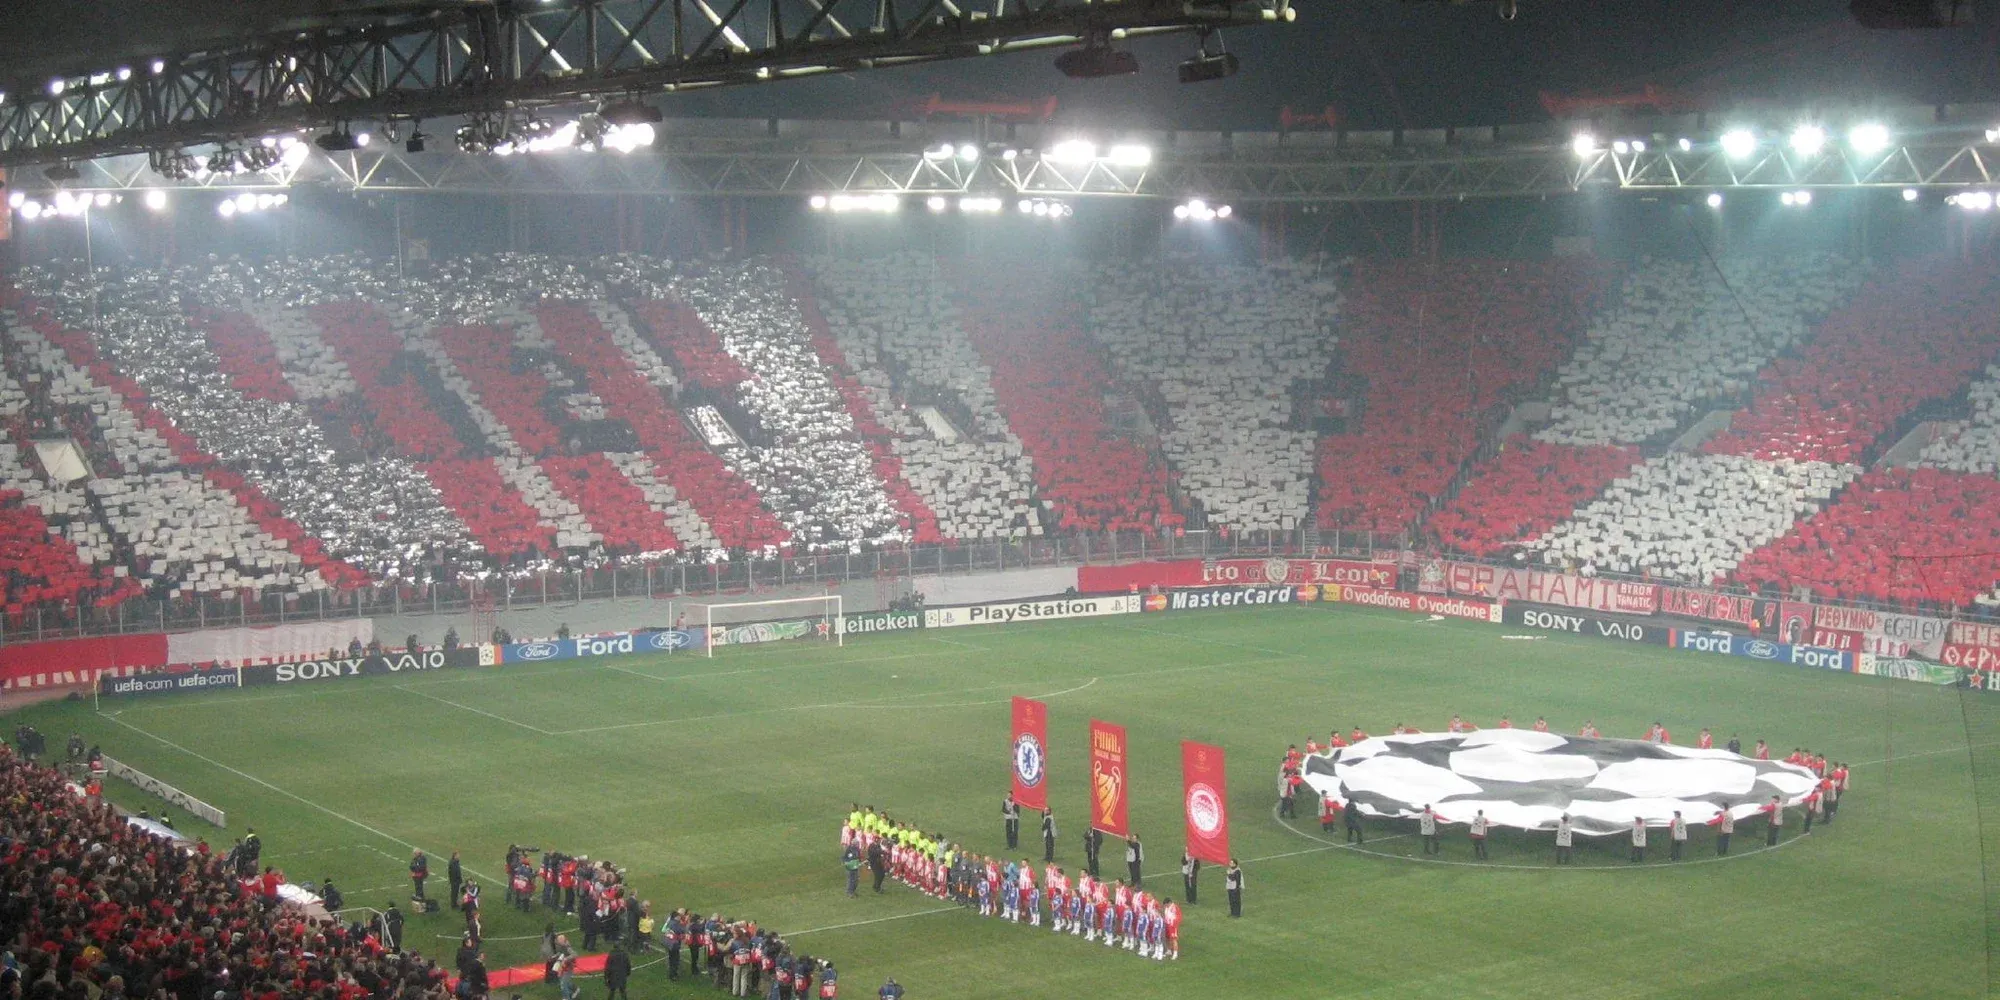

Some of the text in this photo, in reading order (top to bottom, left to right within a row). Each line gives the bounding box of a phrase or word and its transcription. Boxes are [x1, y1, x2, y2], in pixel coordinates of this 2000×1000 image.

[1172, 586, 1291, 609] MasterCard
[1621, 583, 1653, 596] BYRON
[970, 600, 1097, 622] PlayStation
[1356, 591, 1410, 609] vodafone
[1428, 599, 1486, 619] vodafone
[834, 613, 919, 634] Heineken
[1524, 610, 1643, 641] SONY VAIO
[524, 643, 551, 658] Ford
[576, 634, 633, 656] Ford
[1683, 631, 1732, 654] Ford
[1791, 646, 1843, 670] Ford
[276, 658, 365, 682] SONY
[382, 651, 445, 672] VAIO
[1094, 729, 1121, 754] FINAL
